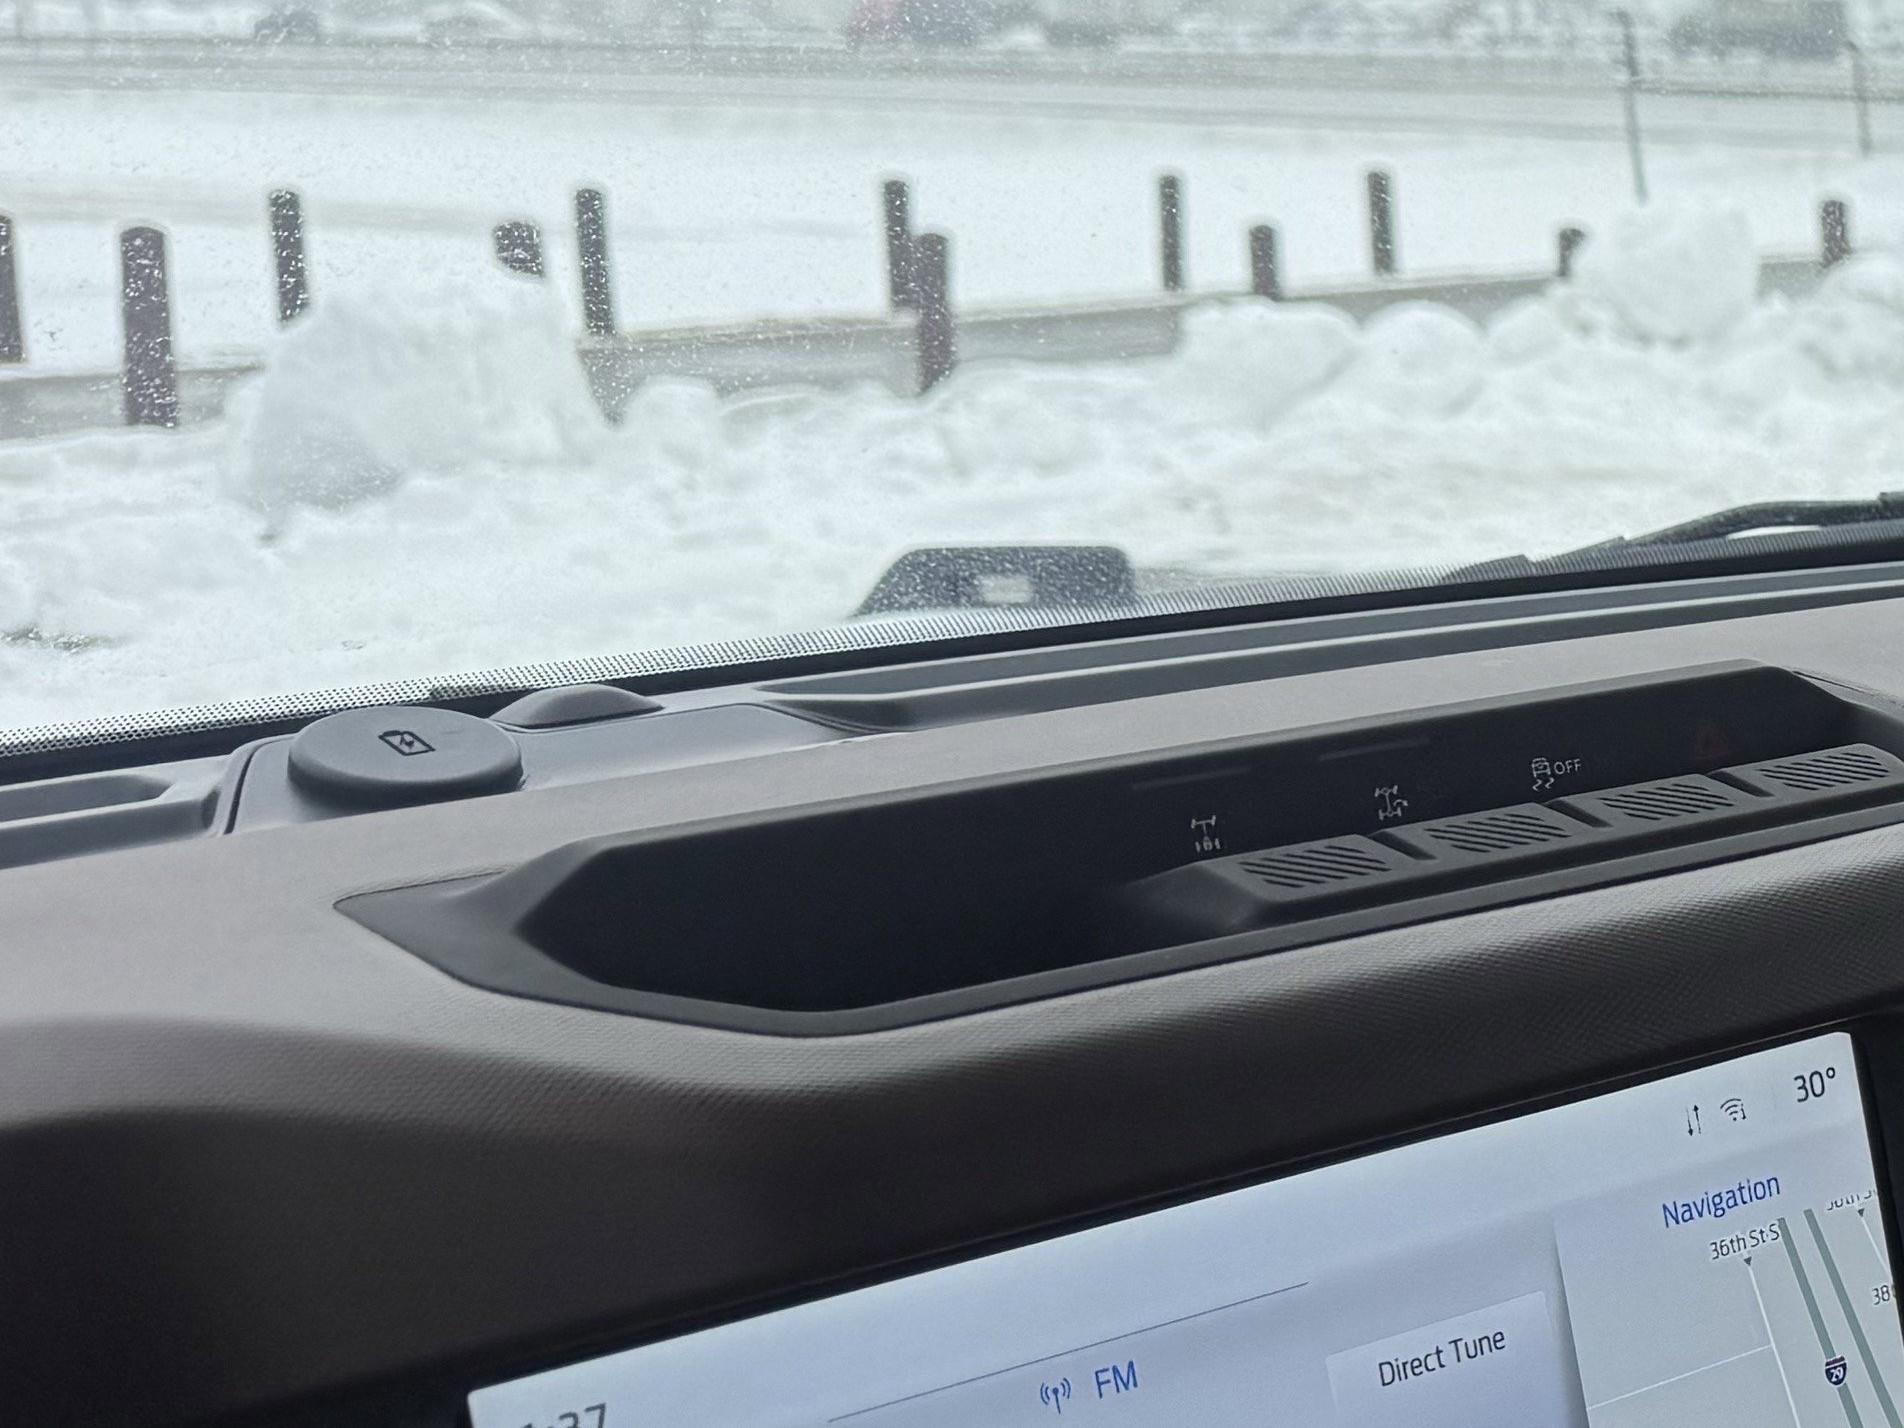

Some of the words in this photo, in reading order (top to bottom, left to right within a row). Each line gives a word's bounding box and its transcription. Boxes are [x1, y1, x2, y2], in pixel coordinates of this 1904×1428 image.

[1554, 758, 1581, 774] OFF
[1792, 1066, 1837, 1103] 30°
[1661, 1176, 1781, 1228] Navigation
[1709, 1234, 1747, 1260] 36th
[1748, 1227, 1767, 1248] St
[1768, 1222, 1780, 1241] S
[1378, 1345, 1446, 1388] Direct
[1449, 1327, 1507, 1363] Tune
[1094, 1360, 1139, 1399] FM
